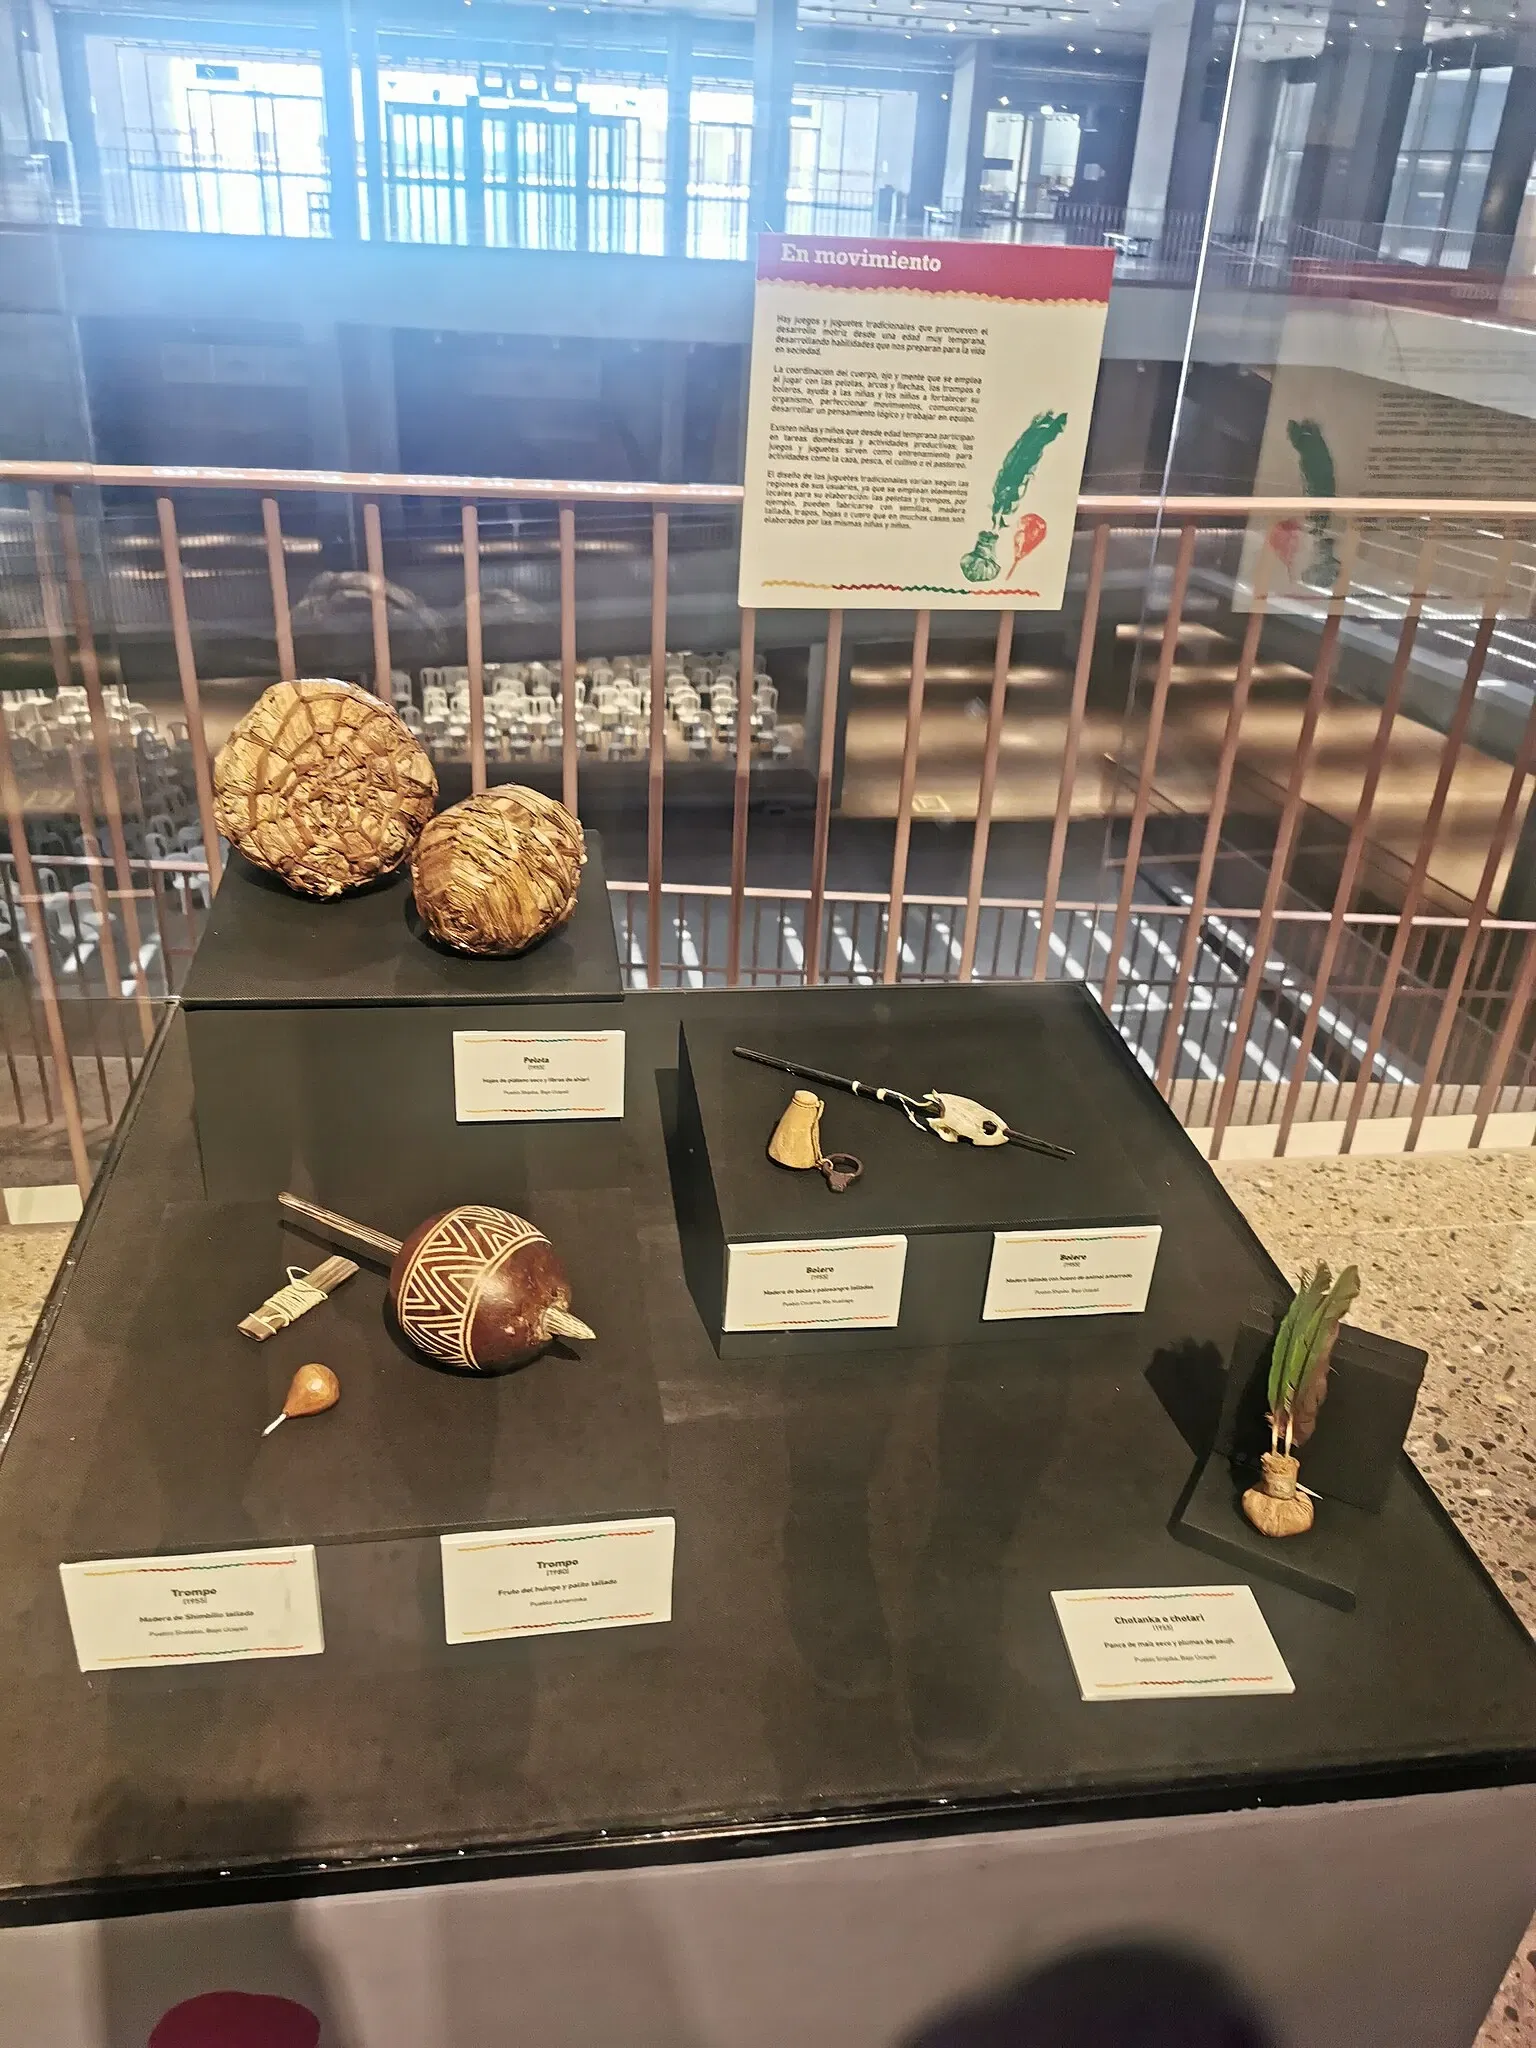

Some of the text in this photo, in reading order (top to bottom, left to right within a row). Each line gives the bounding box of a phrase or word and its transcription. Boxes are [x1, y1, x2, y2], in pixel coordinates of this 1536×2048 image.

[782, 243, 941, 271] En movimiento
[537, 1560, 578, 1568] Trompo
[171, 1589, 217, 1597] Trompo
[1114, 1616, 1161, 1624] Chotanka
